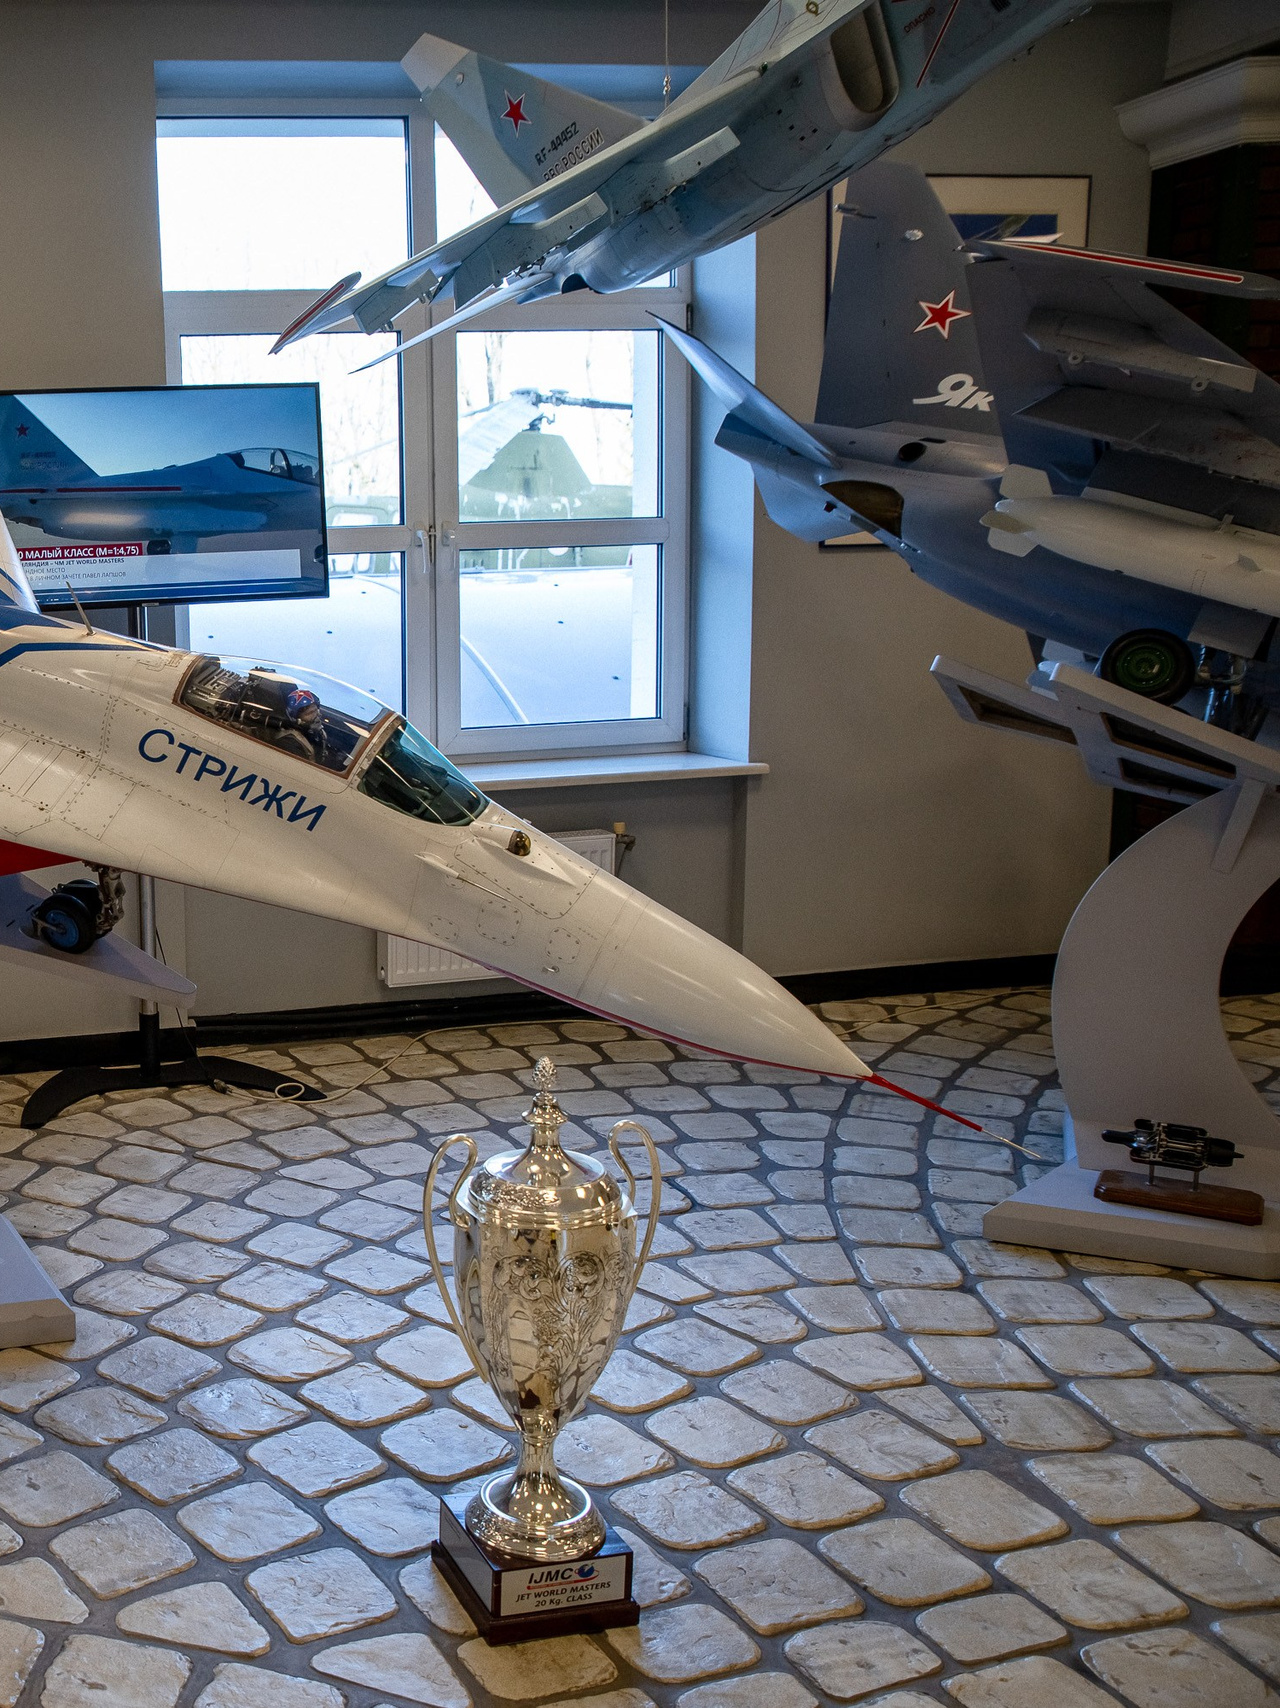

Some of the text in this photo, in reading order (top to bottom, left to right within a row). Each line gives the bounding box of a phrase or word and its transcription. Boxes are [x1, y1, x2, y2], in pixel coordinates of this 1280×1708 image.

[561, 127, 604, 170] РОССИИ
[25, 547, 62, 559] МАЛЫЙ
[64, 547, 95, 557] КЛАСС
[46, 567, 66, 575] МЕСТО
[101, 571, 127, 579] ЛАПШОВ
[138, 729, 328, 832] СТРИЖИ
[528, 1568, 574, 1584] IJMC
[516, 1592, 532, 1602] JET
[534, 1588, 567, 1599] WORLD
[570, 1581, 612, 1593] MASTERS
[549, 1597, 563, 1606] Kg.
[566, 1593, 593, 1603] CLASS
